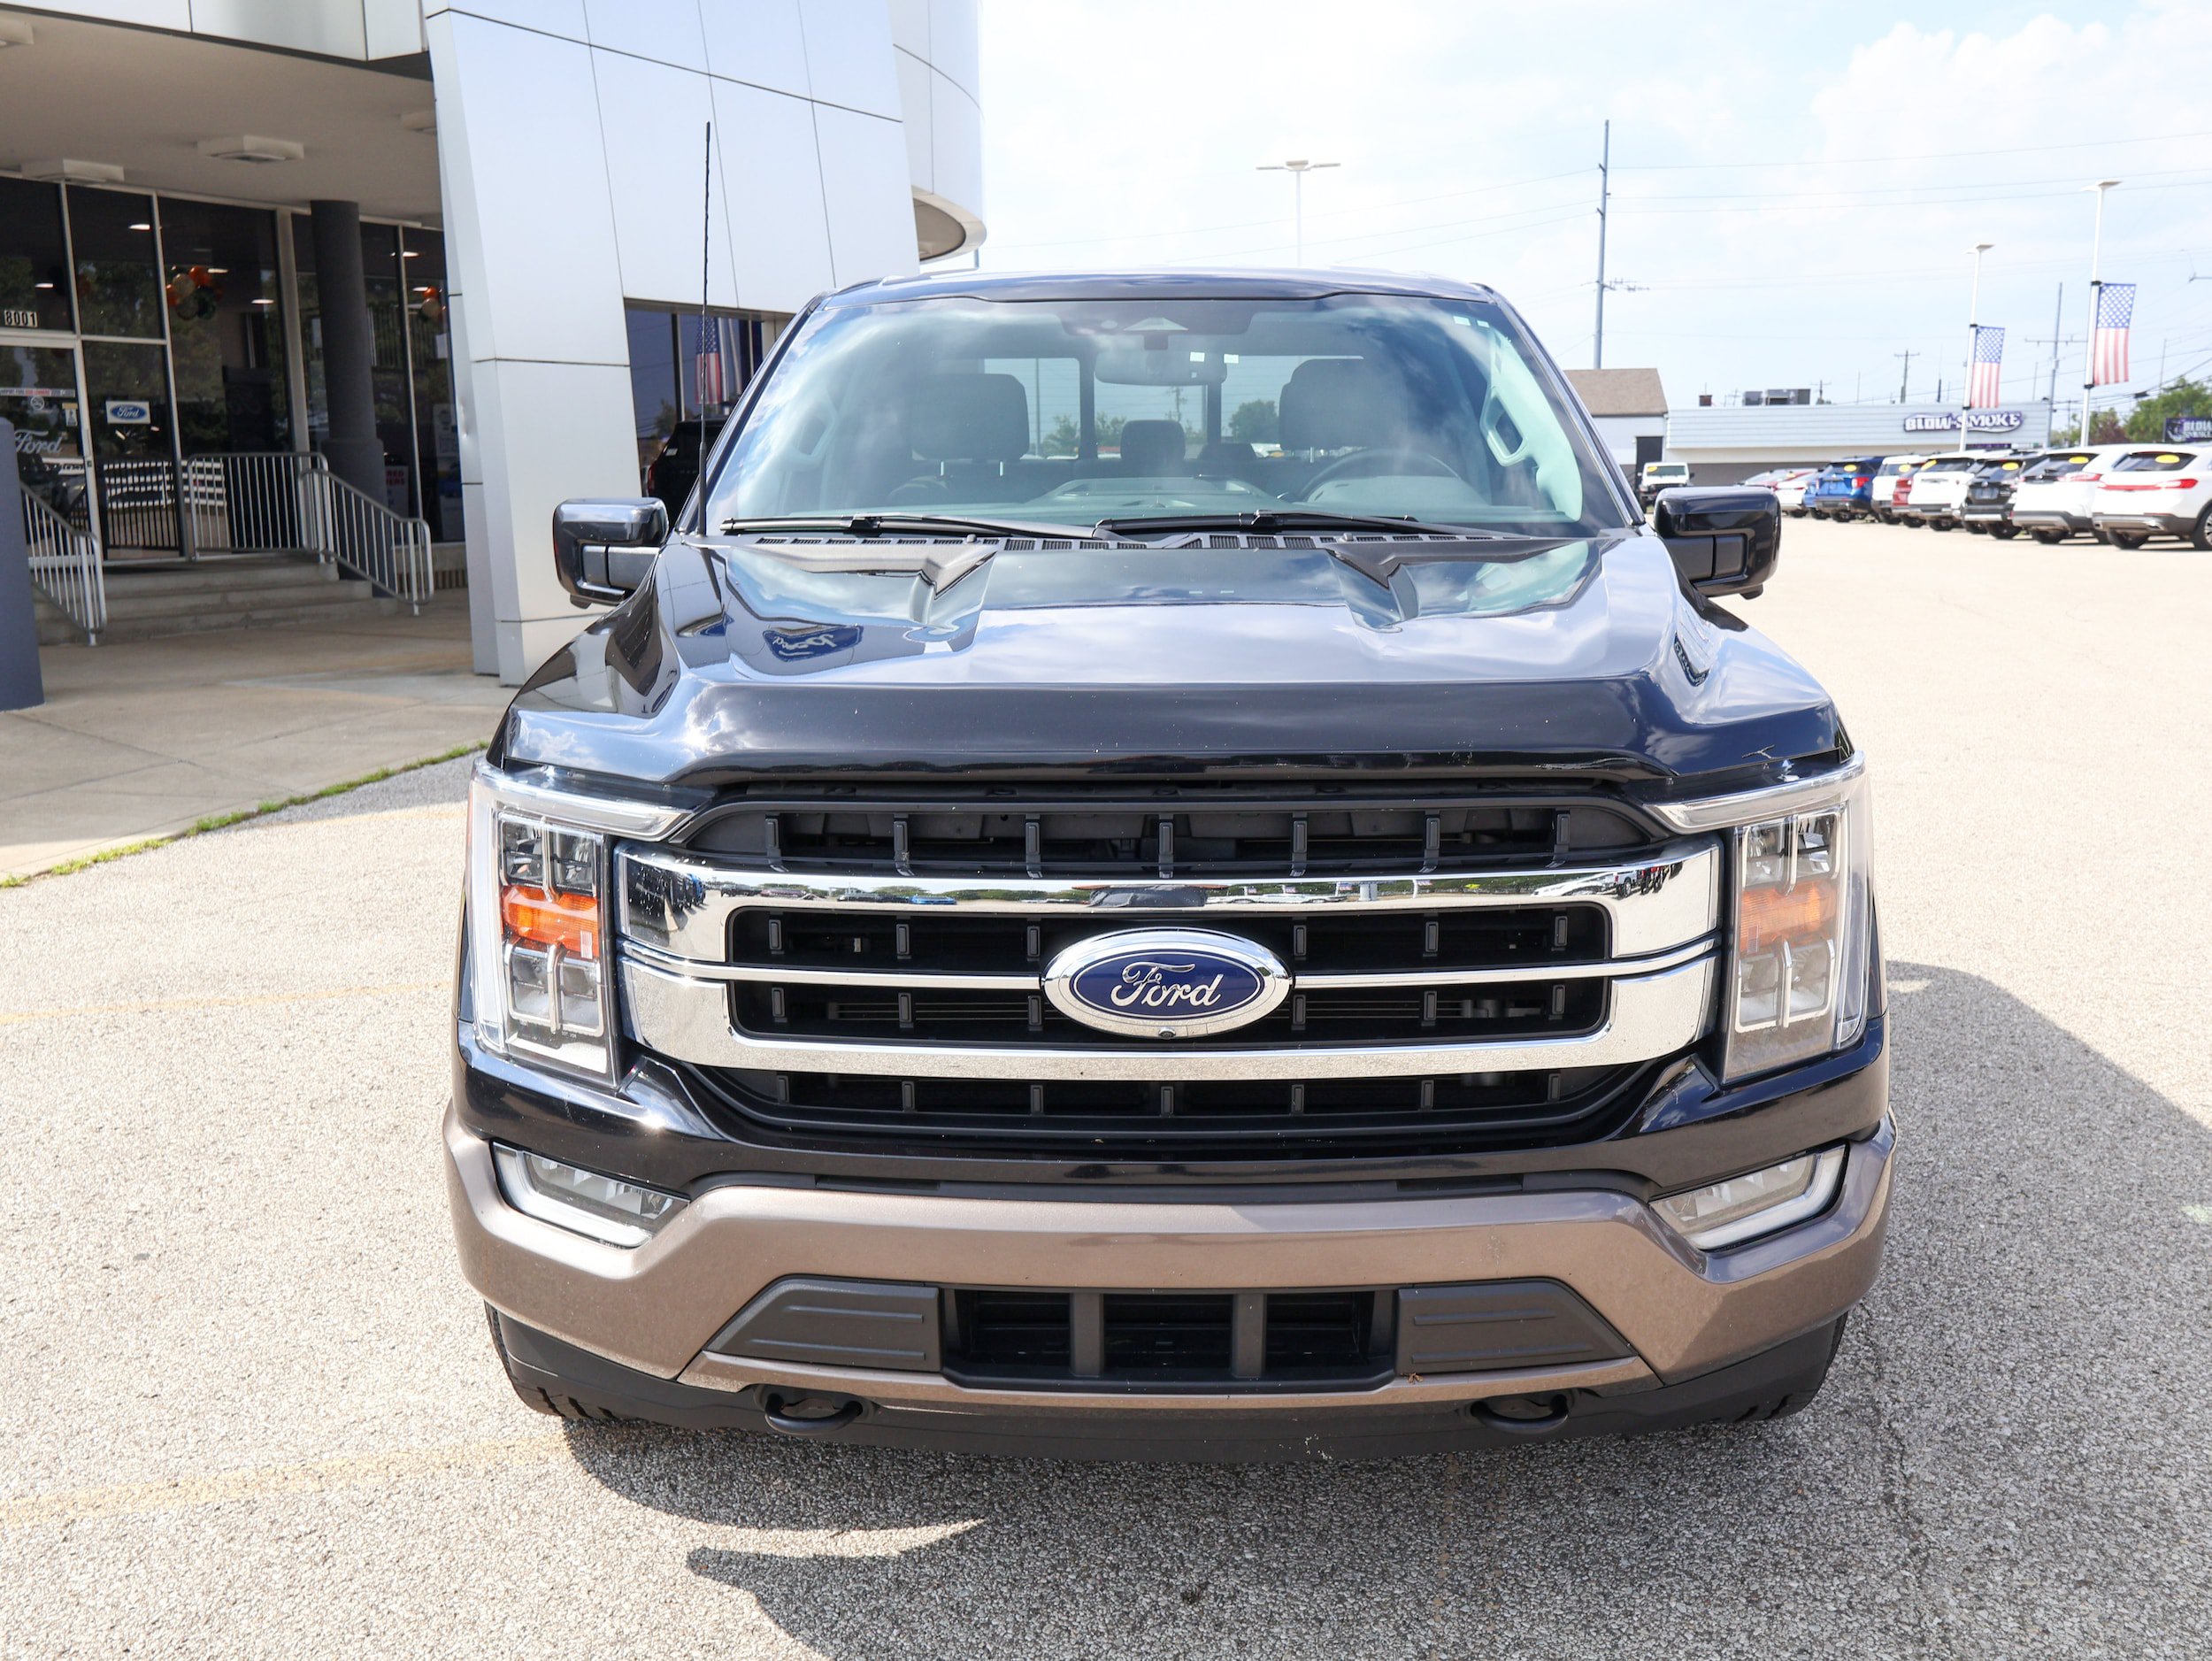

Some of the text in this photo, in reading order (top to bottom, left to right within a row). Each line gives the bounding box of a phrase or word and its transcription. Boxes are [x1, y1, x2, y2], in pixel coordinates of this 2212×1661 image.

[5, 311, 35, 326] 8001
[116, 406, 140, 418] Ford
[14, 429, 62, 454] Ford
[1110, 961, 1225, 1007] Ford
